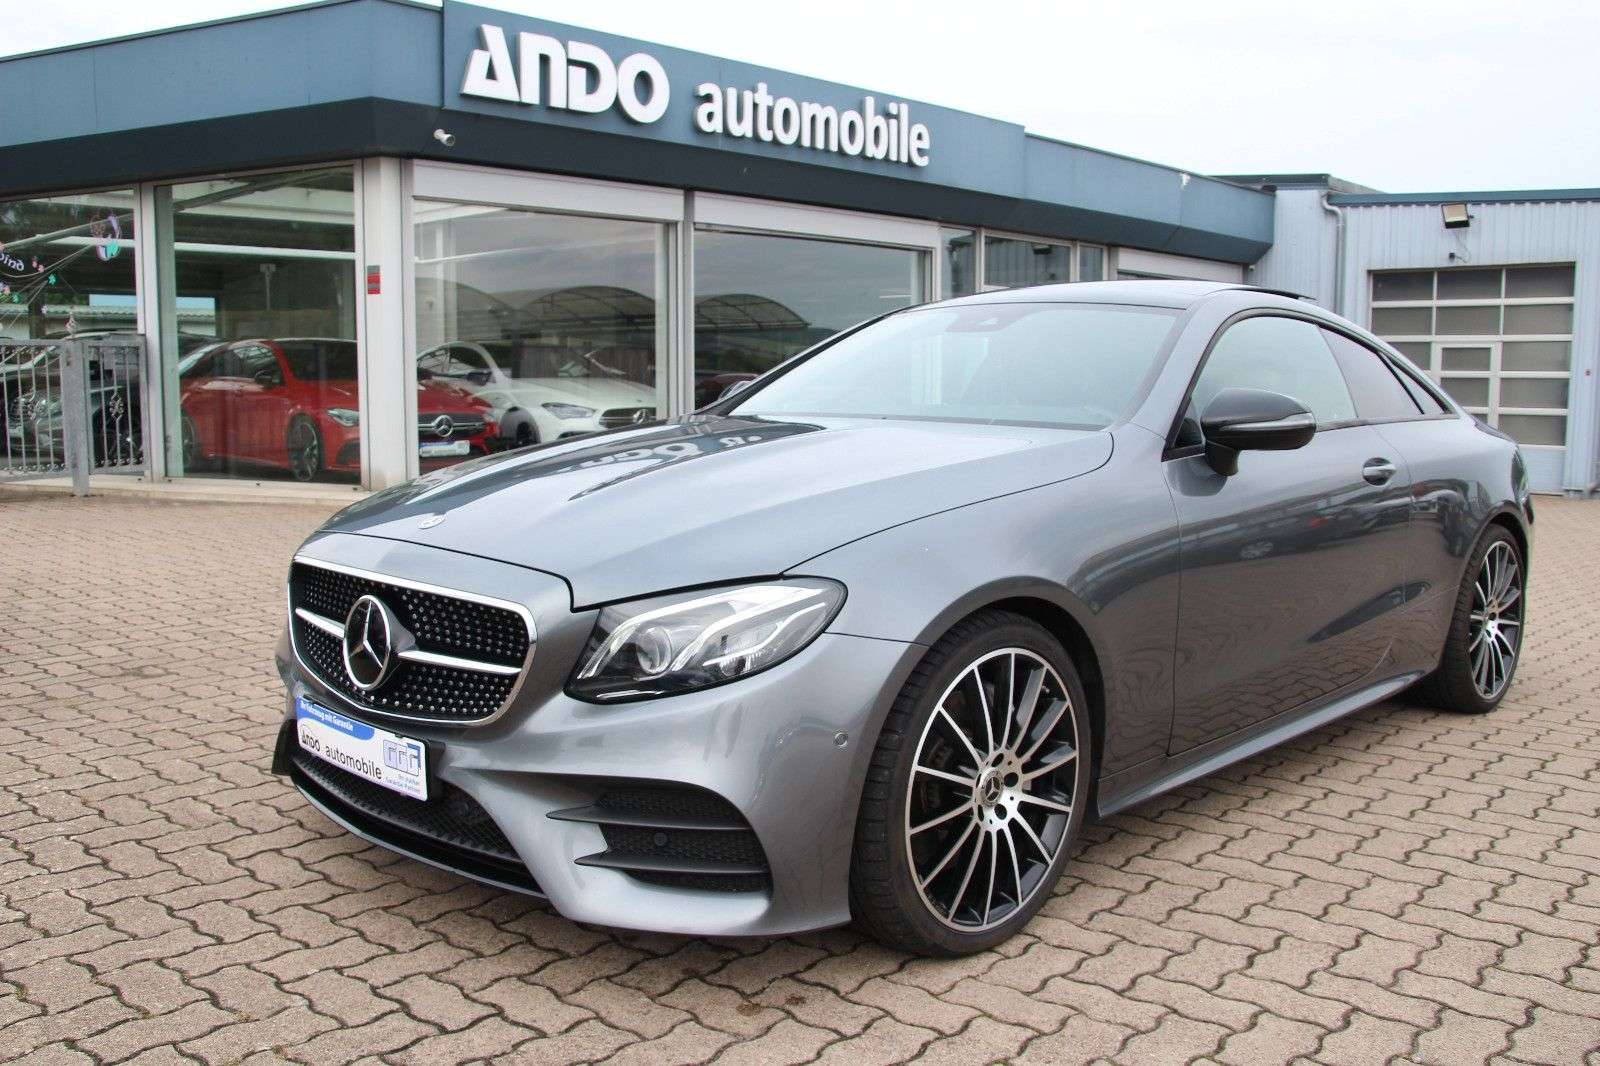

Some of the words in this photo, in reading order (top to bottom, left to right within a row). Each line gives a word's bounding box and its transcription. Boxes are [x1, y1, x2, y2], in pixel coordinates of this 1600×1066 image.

[460, 23, 670, 123] ANDO
[694, 81, 930, 167] automobile
[326, 744, 382, 780] automobile
